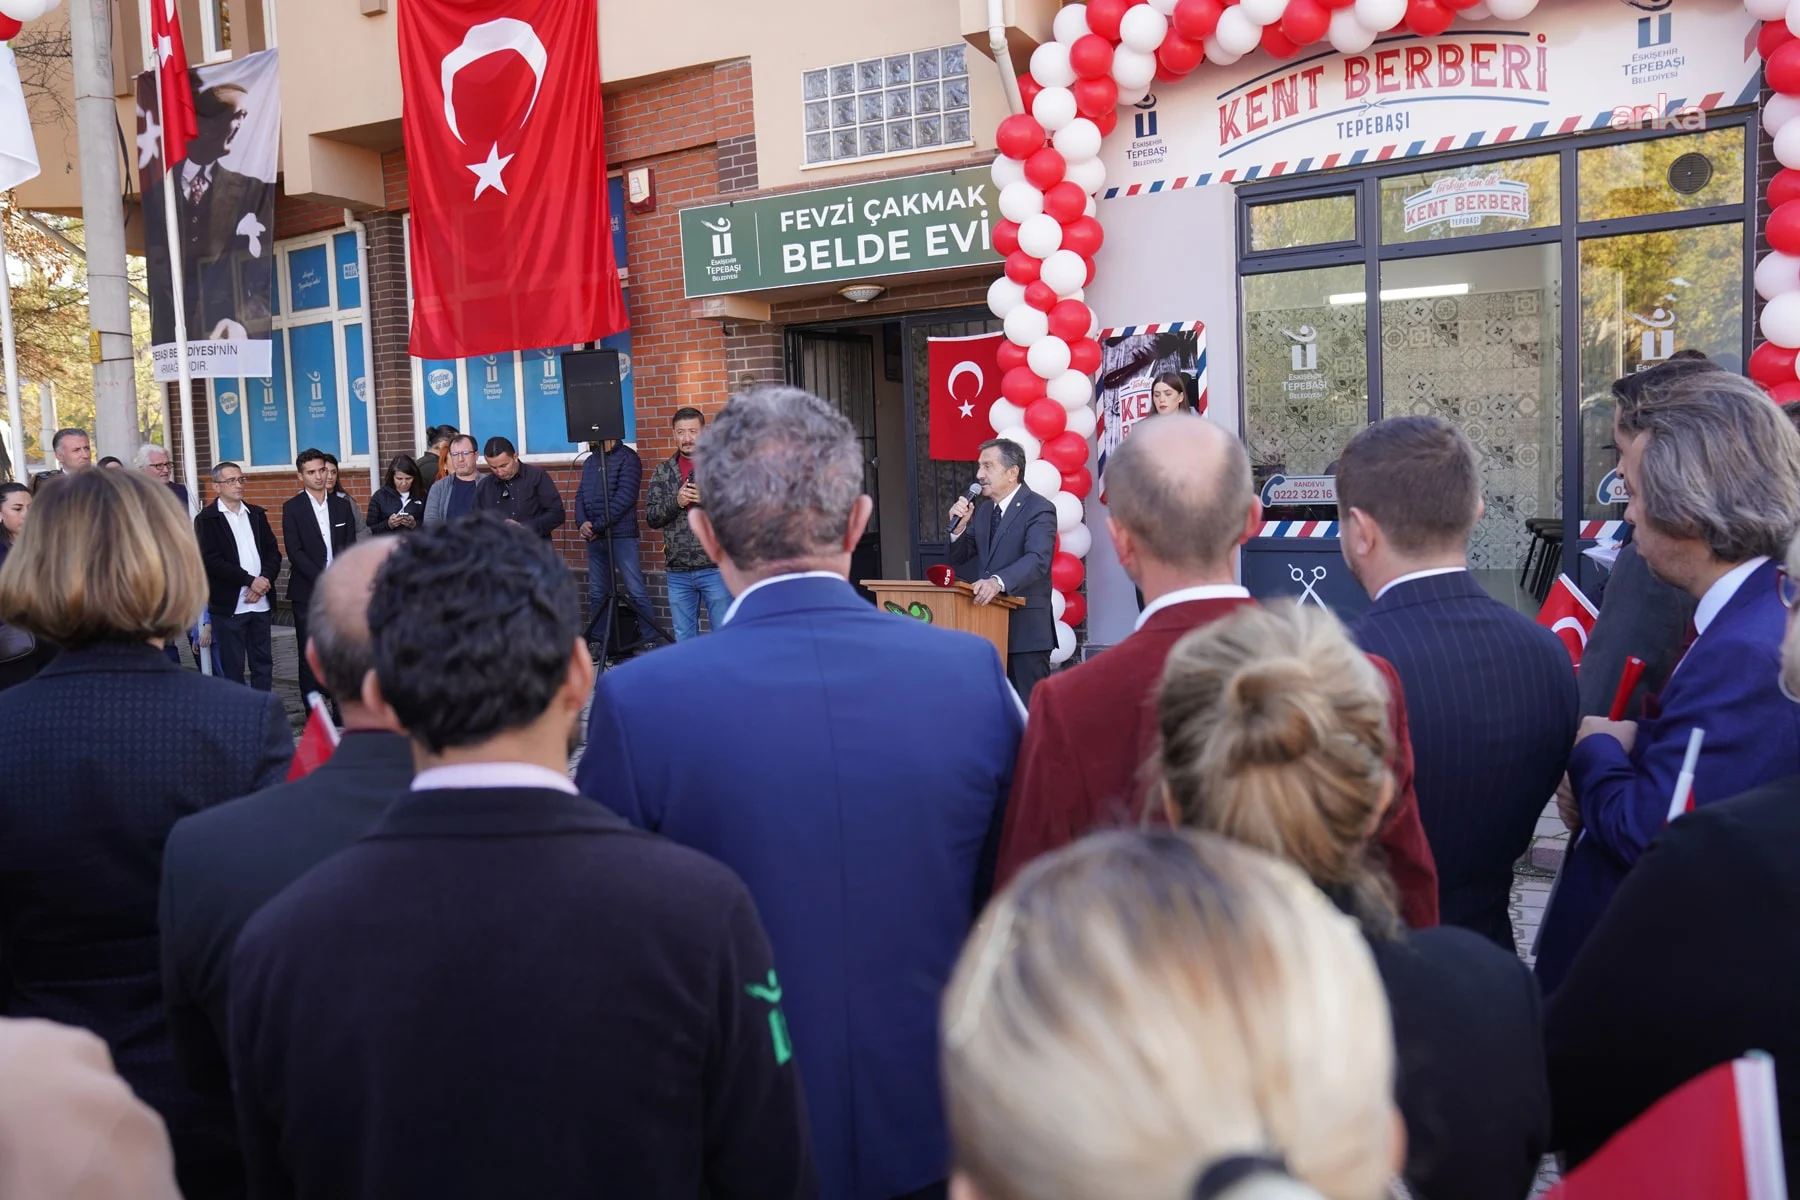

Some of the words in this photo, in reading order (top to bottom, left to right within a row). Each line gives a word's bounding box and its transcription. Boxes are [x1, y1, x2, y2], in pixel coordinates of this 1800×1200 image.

[1632, 47, 1679, 62] ESKİŞEHİR
[1622, 56, 1685, 76] TEPEBAŞI
[1631, 71, 1678, 85] BELEDİYESİ
[1218, 65, 1324, 146] KENT
[1344, 33, 1548, 100] BERBERİ
[1336, 111, 1410, 140] TEPEBAŞI
[1126, 146, 1168, 160] TEPEBAŞI
[780, 196, 854, 232] FEVZİ
[863, 184, 987, 227] ÇAKMAK
[1406, 199, 1448, 226] KENT
[1454, 193, 1527, 213] BERBERİ
[782, 229, 911, 274] BELDE
[925, 209, 990, 257] EVİ
[706, 264, 741, 275] TEPEBAŞI
[169, 344, 238, 359] BEDİYESİ'NİN
[1282, 380, 1327, 392] TEPEBAŞI
[1121, 393, 1150, 423] KE
[1273, 490, 1298, 499] 0222
[1301, 489, 1320, 499] 322
[1322, 489, 1333, 499] 16
